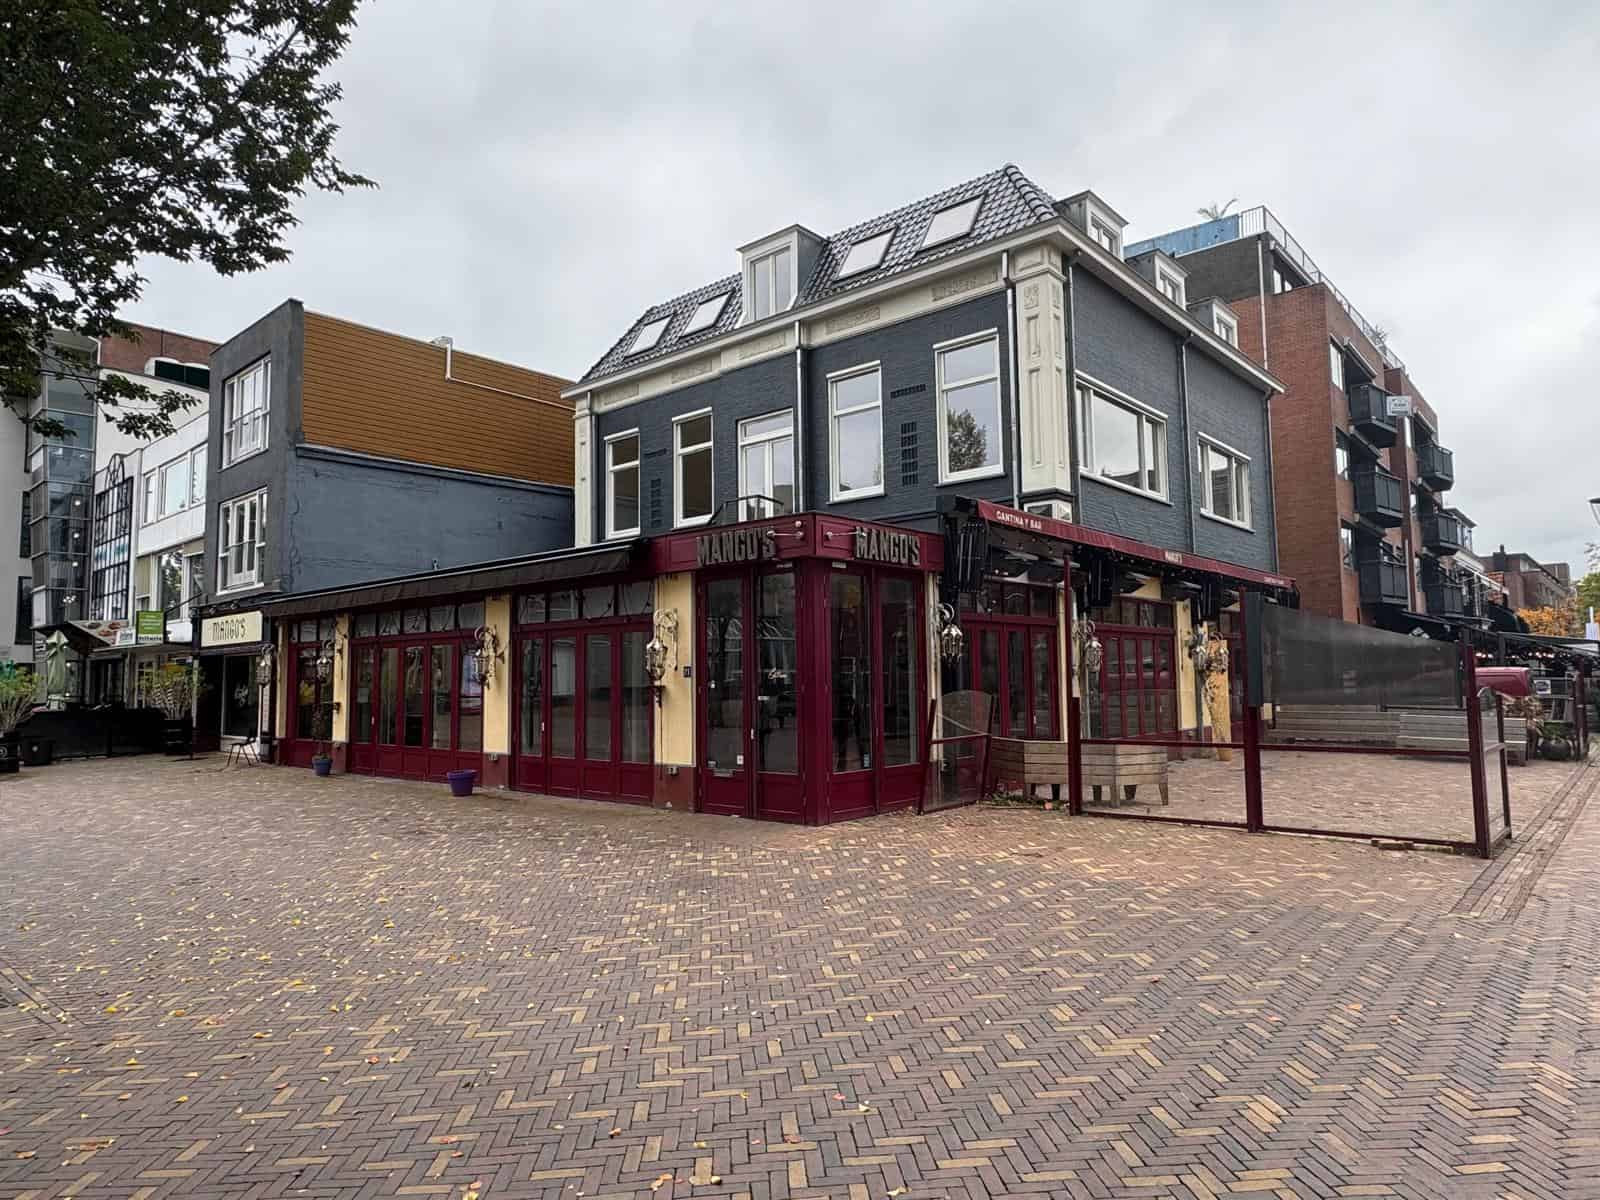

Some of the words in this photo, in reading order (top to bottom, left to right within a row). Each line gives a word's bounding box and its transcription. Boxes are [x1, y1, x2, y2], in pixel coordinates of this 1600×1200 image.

[996, 510, 1024, 525] CANTINA
[696, 526, 777, 568] MANGO'S
[855, 526, 921, 566] MANGO'S
[212, 617, 247, 641] MANGO'S
